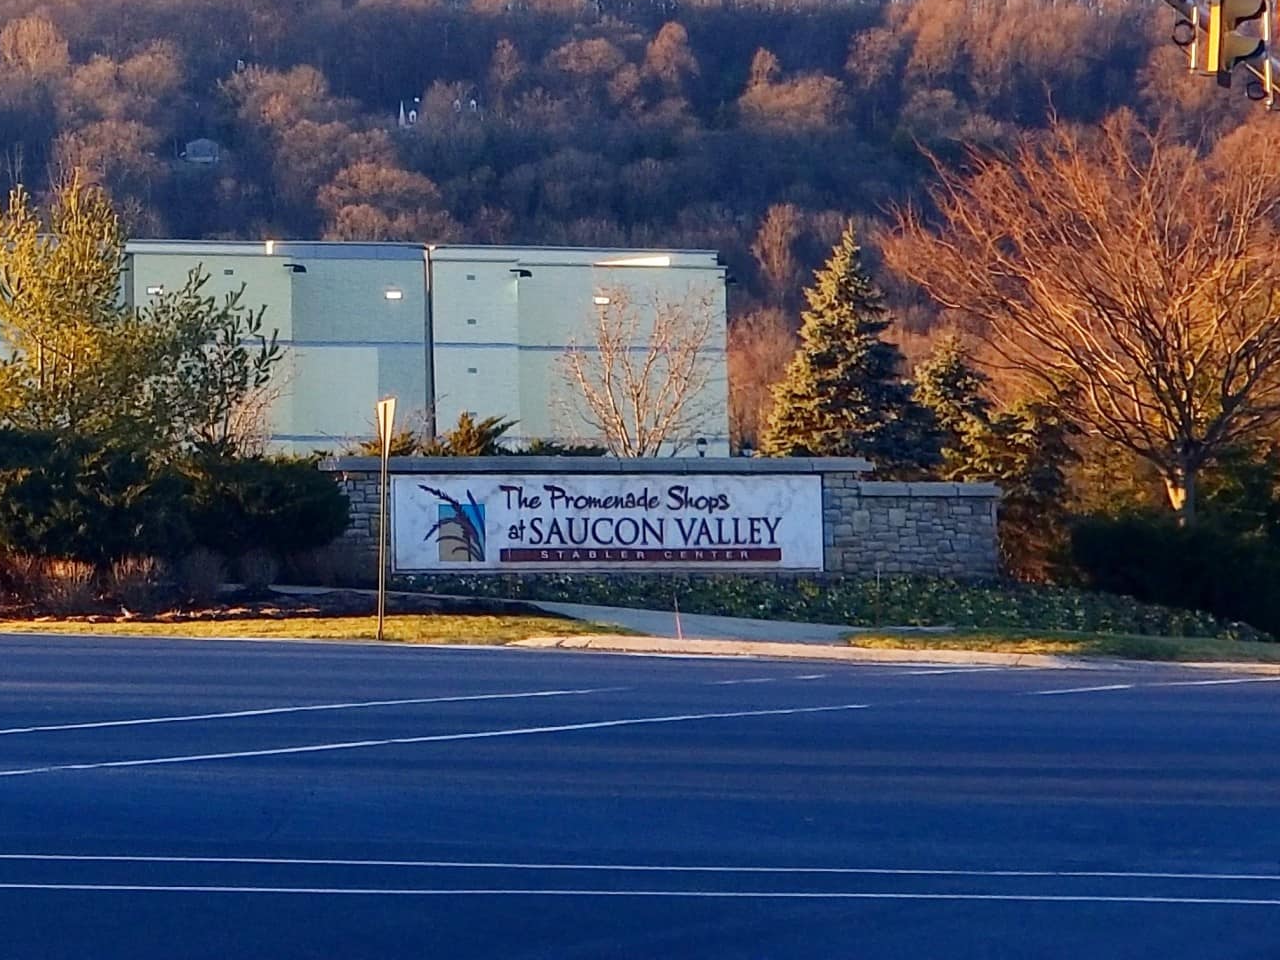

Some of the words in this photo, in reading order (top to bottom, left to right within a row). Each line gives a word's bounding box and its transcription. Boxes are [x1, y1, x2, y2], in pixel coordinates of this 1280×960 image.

[499, 485, 542, 510] The
[543, 485, 660, 511] Promenade
[666, 485, 730, 514] Shops
[508, 519, 526, 542] at
[529, 517, 665, 546] SAUCON
[673, 517, 782, 546] VALLEY
[540, 550, 646, 560] STABLER
[664, 550, 749, 560] CENTER
